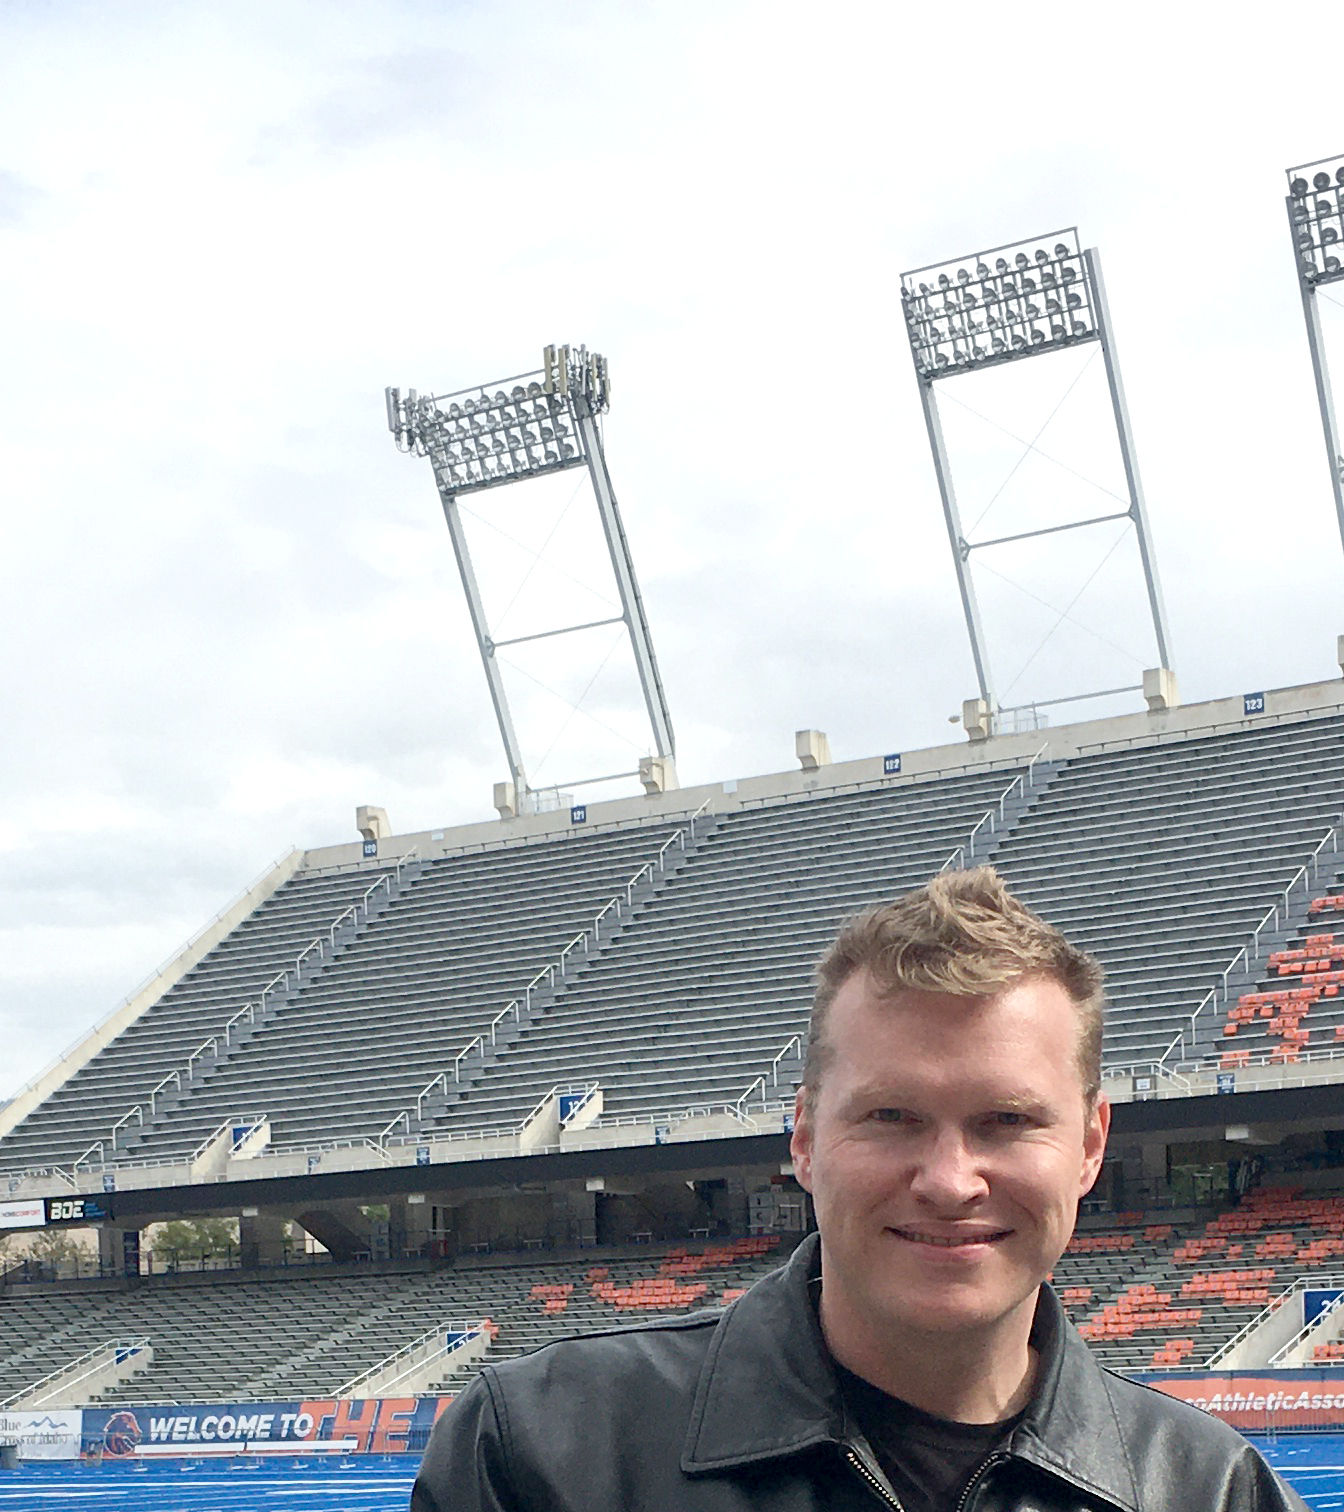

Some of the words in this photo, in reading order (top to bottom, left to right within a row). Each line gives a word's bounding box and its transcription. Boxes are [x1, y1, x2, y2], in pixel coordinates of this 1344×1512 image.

[1245, 698, 1263, 710] 123
[150, 1414, 275, 1441] WELCOME
[281, 1413, 314, 1438] TO
[298, 1398, 419, 1453] THE
